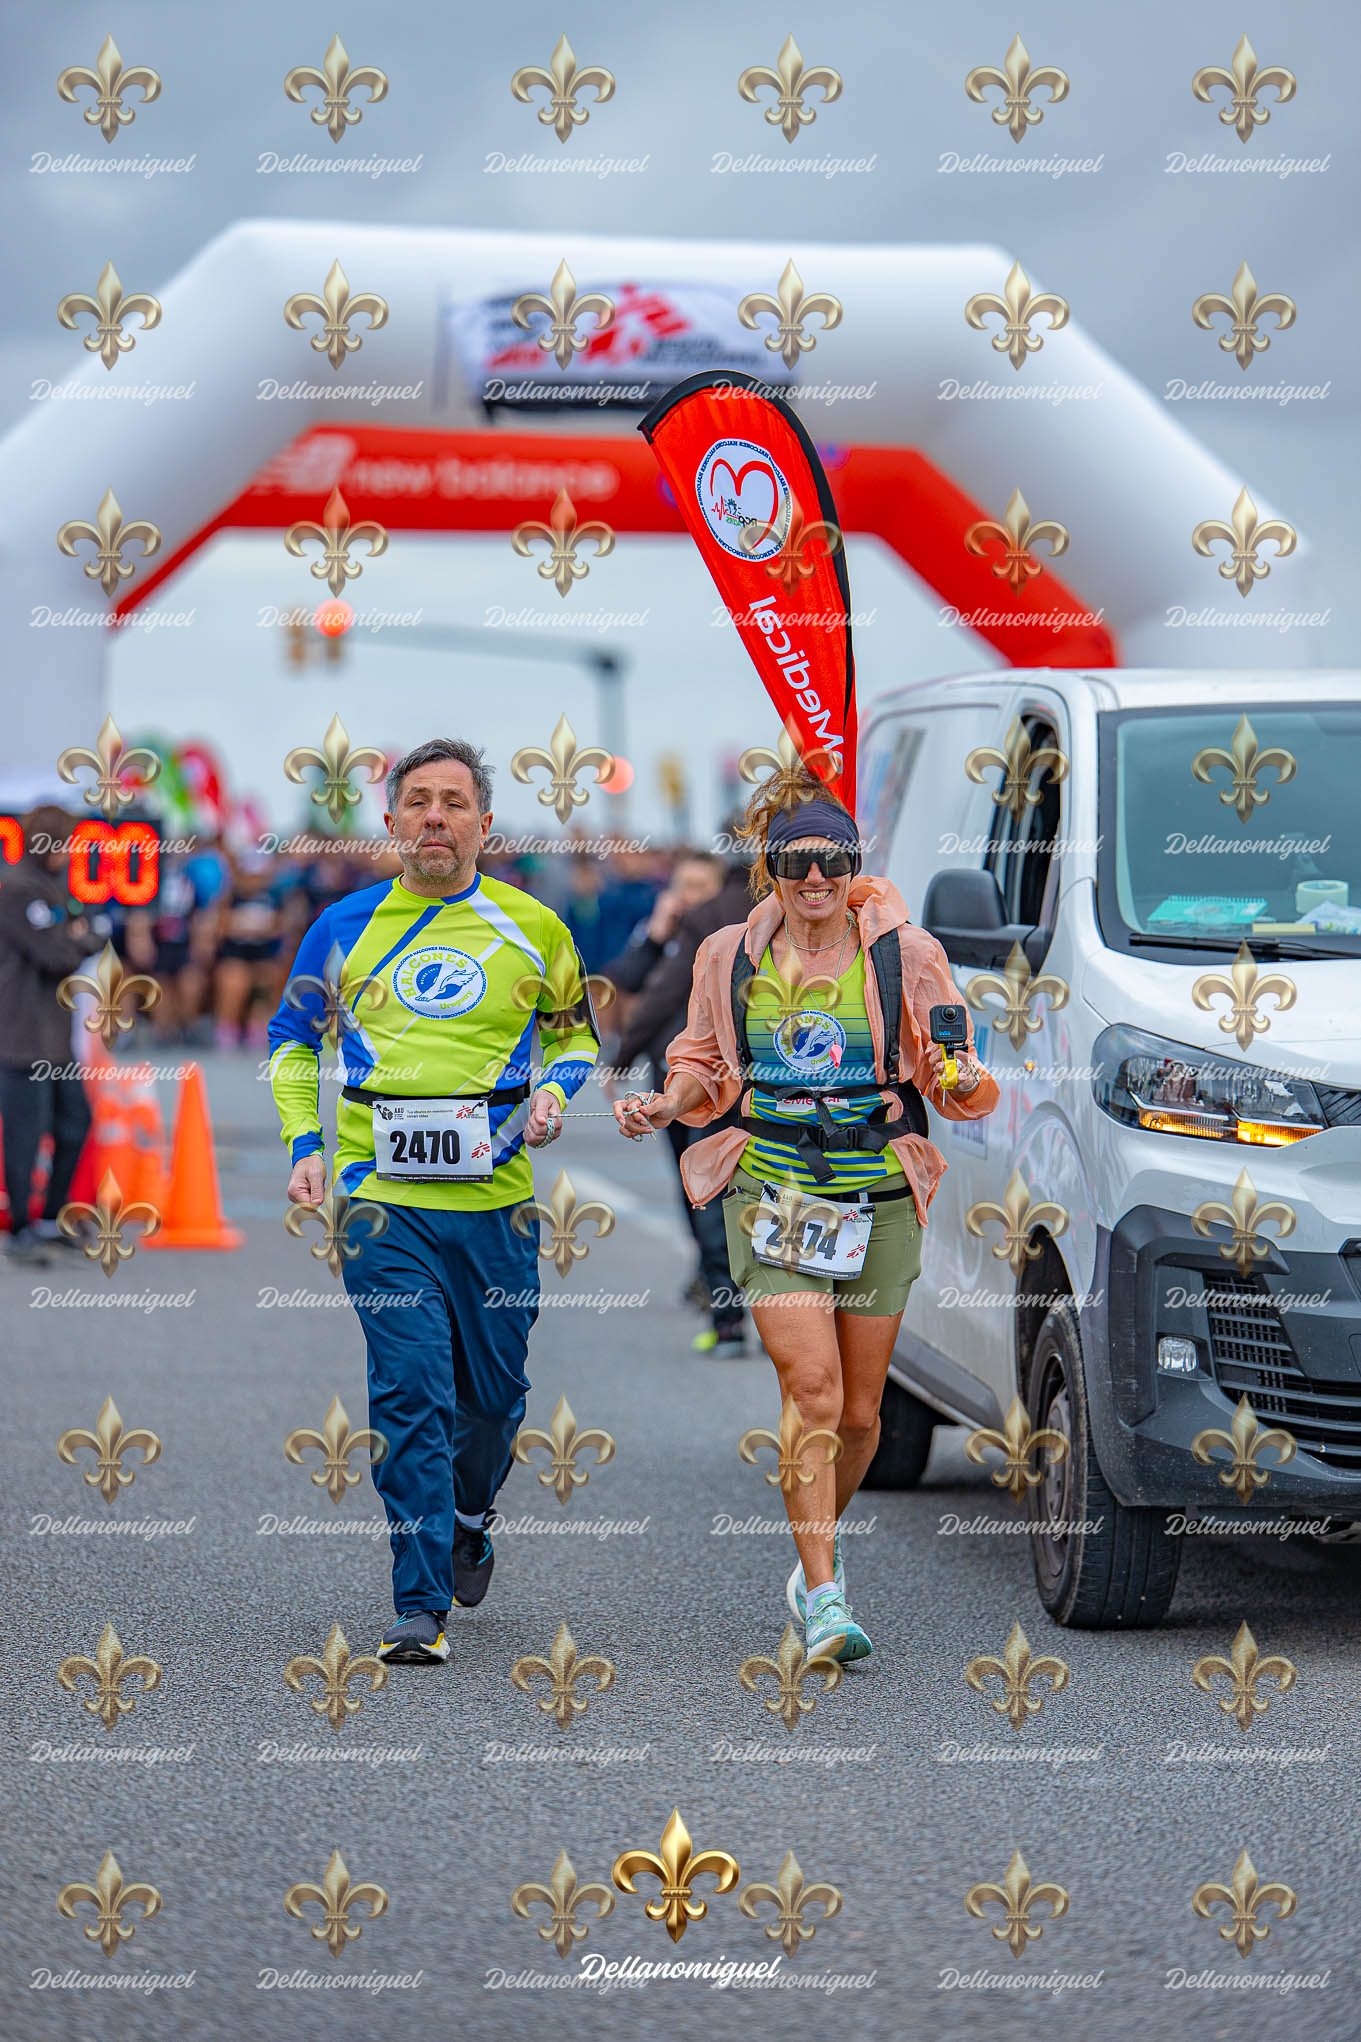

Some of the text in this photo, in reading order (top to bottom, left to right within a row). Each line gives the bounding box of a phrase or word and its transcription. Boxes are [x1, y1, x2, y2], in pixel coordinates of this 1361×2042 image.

[401, 952, 468, 998] HALCONES
[389, 1129, 461, 1165] 2470
[765, 1214, 839, 1260] 2474
